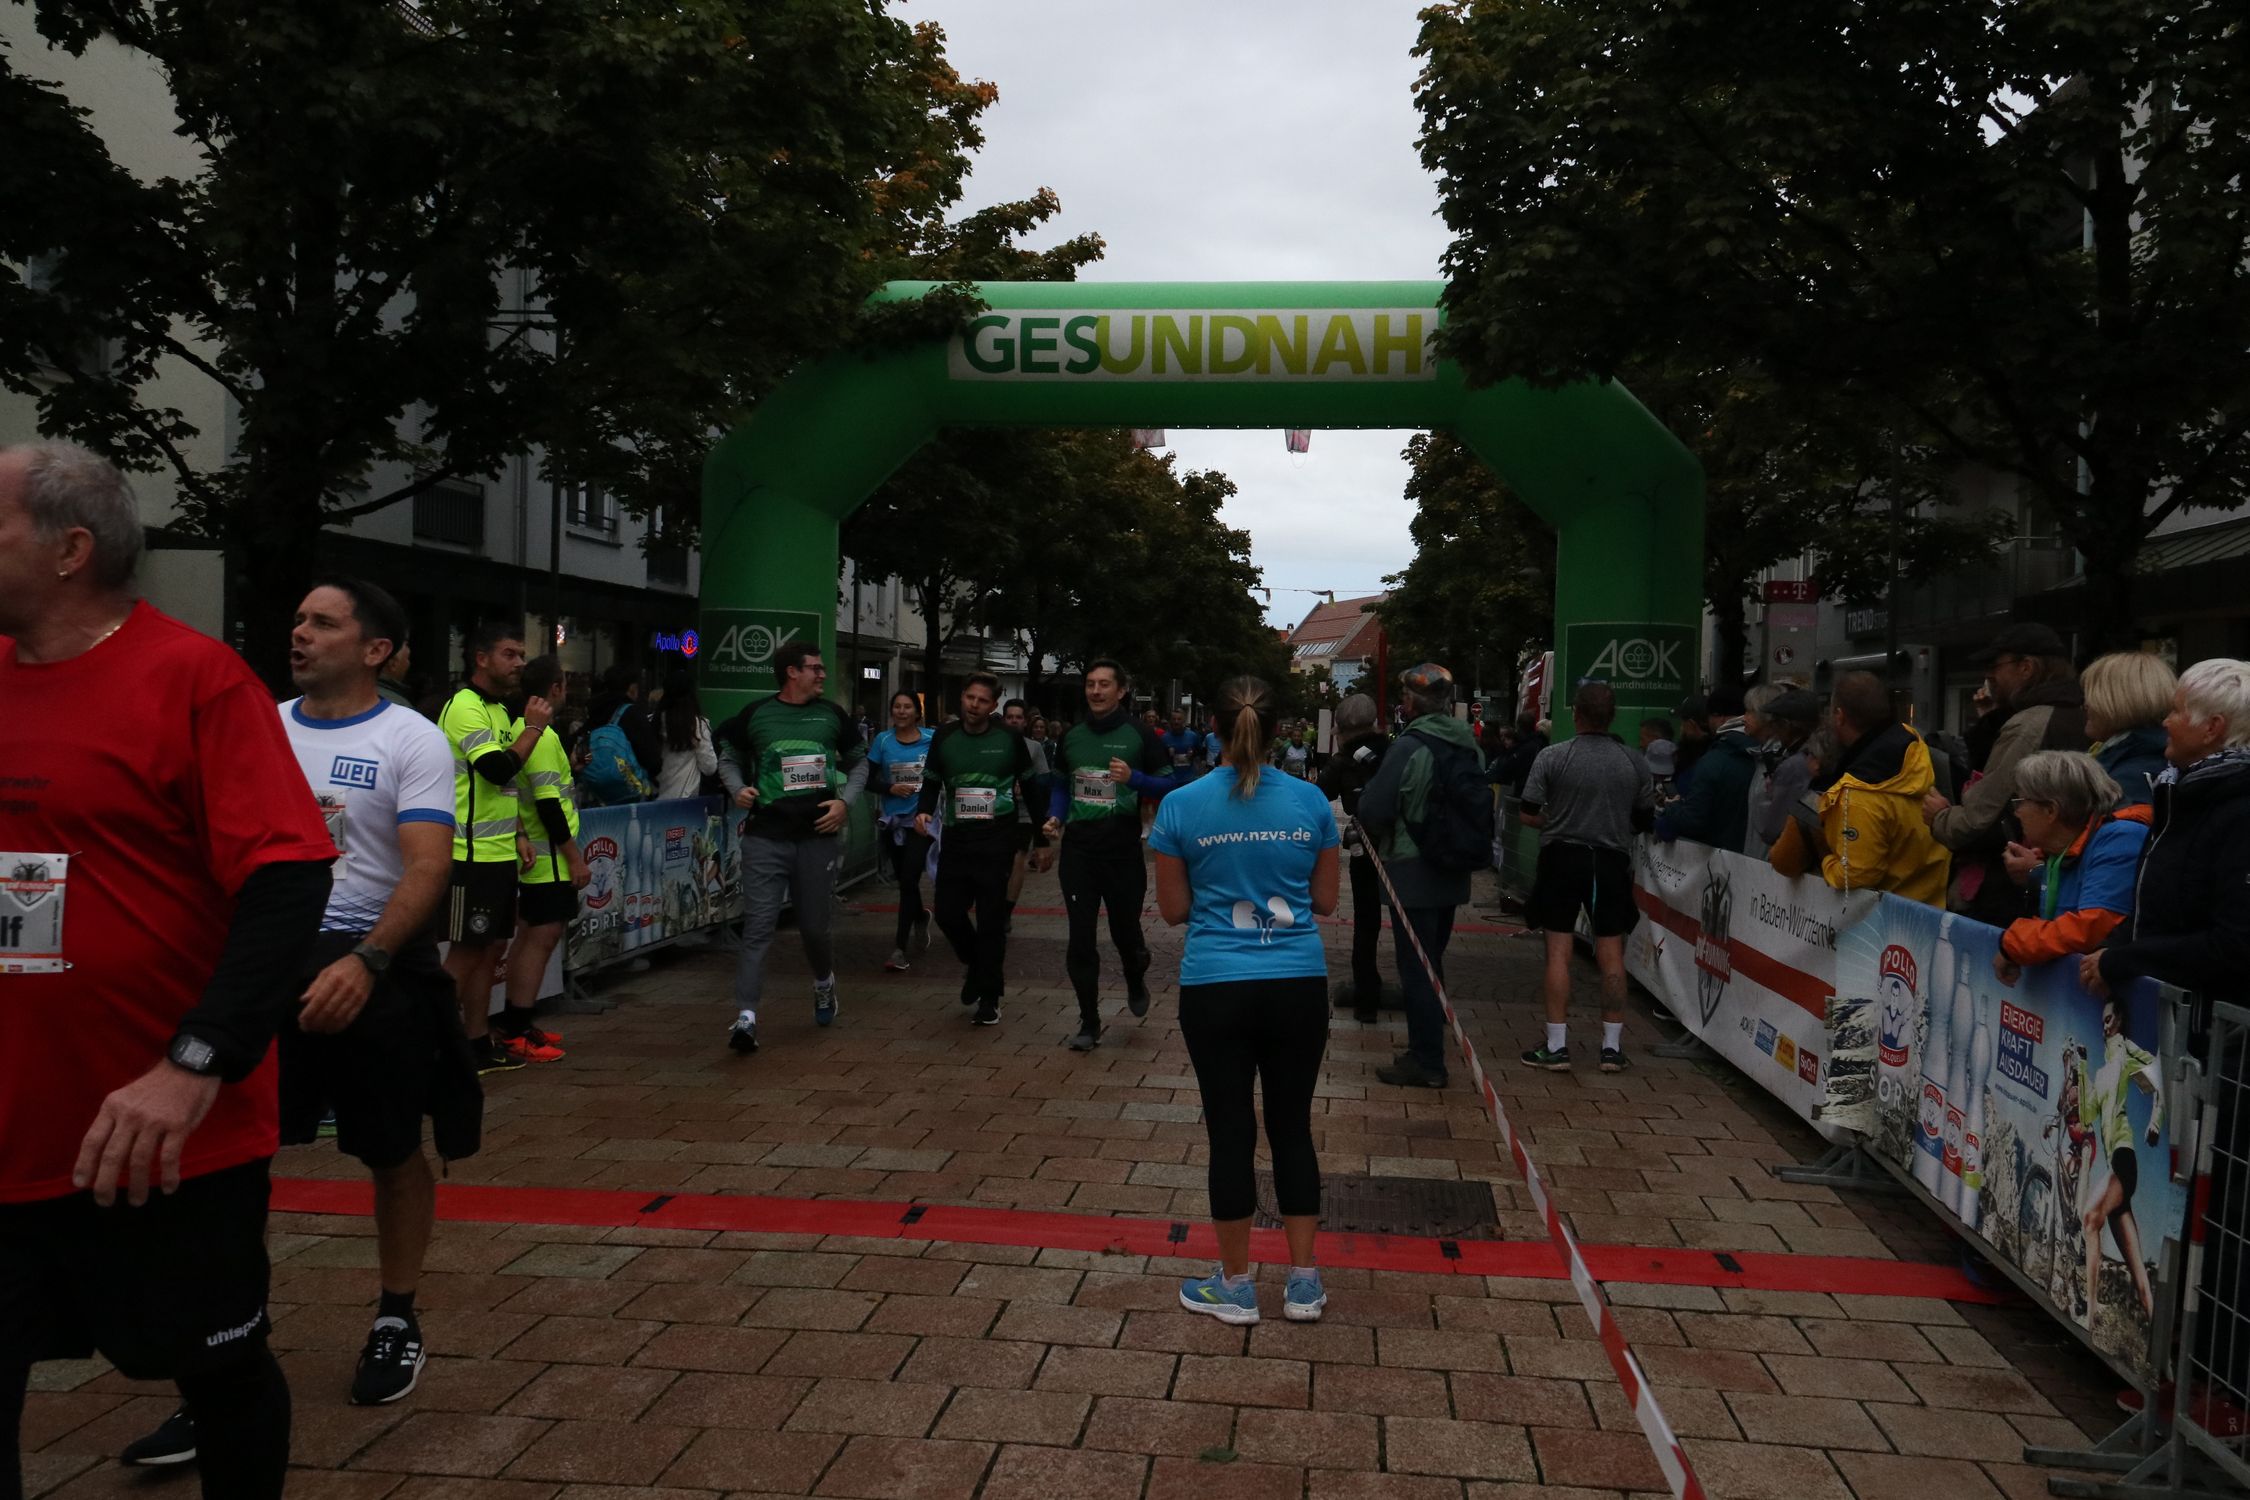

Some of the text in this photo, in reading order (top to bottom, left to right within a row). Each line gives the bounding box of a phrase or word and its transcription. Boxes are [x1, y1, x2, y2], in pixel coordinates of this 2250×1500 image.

[963, 313, 1422, 375] GESUNDNAH
[656, 631, 681, 653] Apollo
[721, 664, 776, 674] Gesundheits
[1583, 638, 1681, 679] AOK
[790, 773, 821, 783] Stefan
[895, 775, 921, 784] Sabine
[1084, 786, 1103, 797] Max
[960, 803, 988, 813] Daniel
[1197, 827, 1312, 848] www.nzvs.de
[0, 915, 23, 947] lf
[581, 911, 619, 937] SPRT
[1882, 950, 1915, 985] POLLO
[2002, 1004, 2042, 1040] ENERGIE
[1998, 1051, 2045, 1095] AUSDAUER
